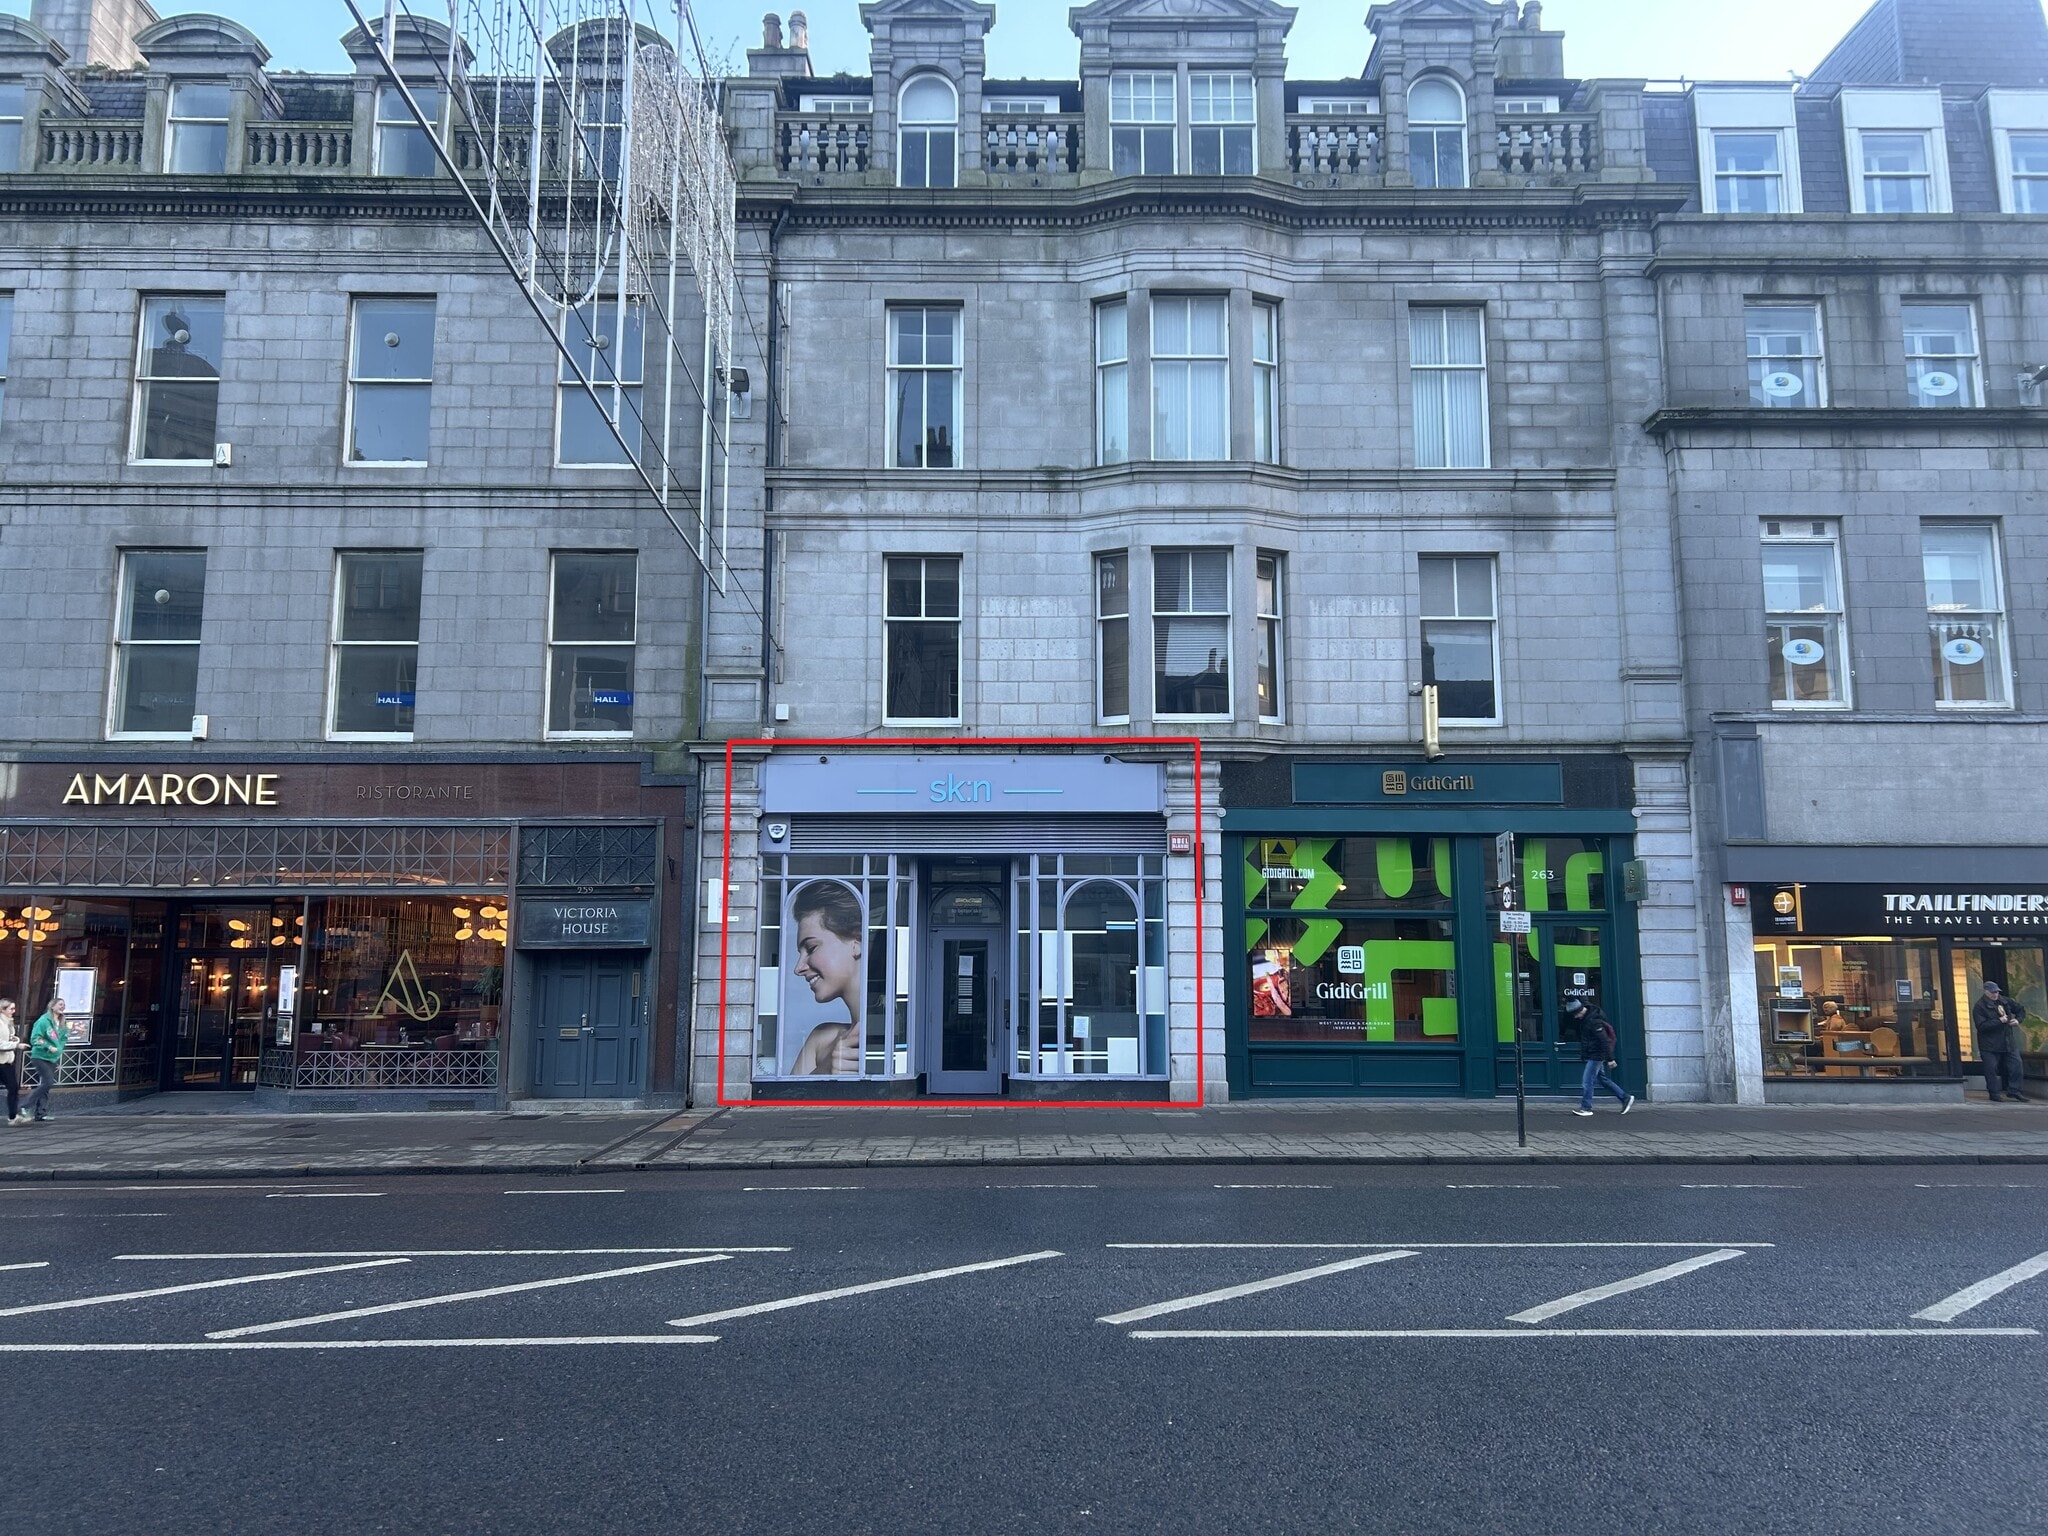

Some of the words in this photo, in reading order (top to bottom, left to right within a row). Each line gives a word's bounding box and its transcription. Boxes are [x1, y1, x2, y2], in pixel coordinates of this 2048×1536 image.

[62, 772, 281, 806] AMARONE
[356, 784, 473, 801] RISTORANTE
[1261, 868, 1315, 879] GIDIGRILL.COM
[1531, 869, 1554, 880] 263
[577, 886, 594, 894] 259
[554, 906, 618, 920] VICTORIA
[1884, 916, 1913, 925] THE
[1924, 916, 1982, 925] TRAVEL
[562, 921, 609, 935] HOUSE
